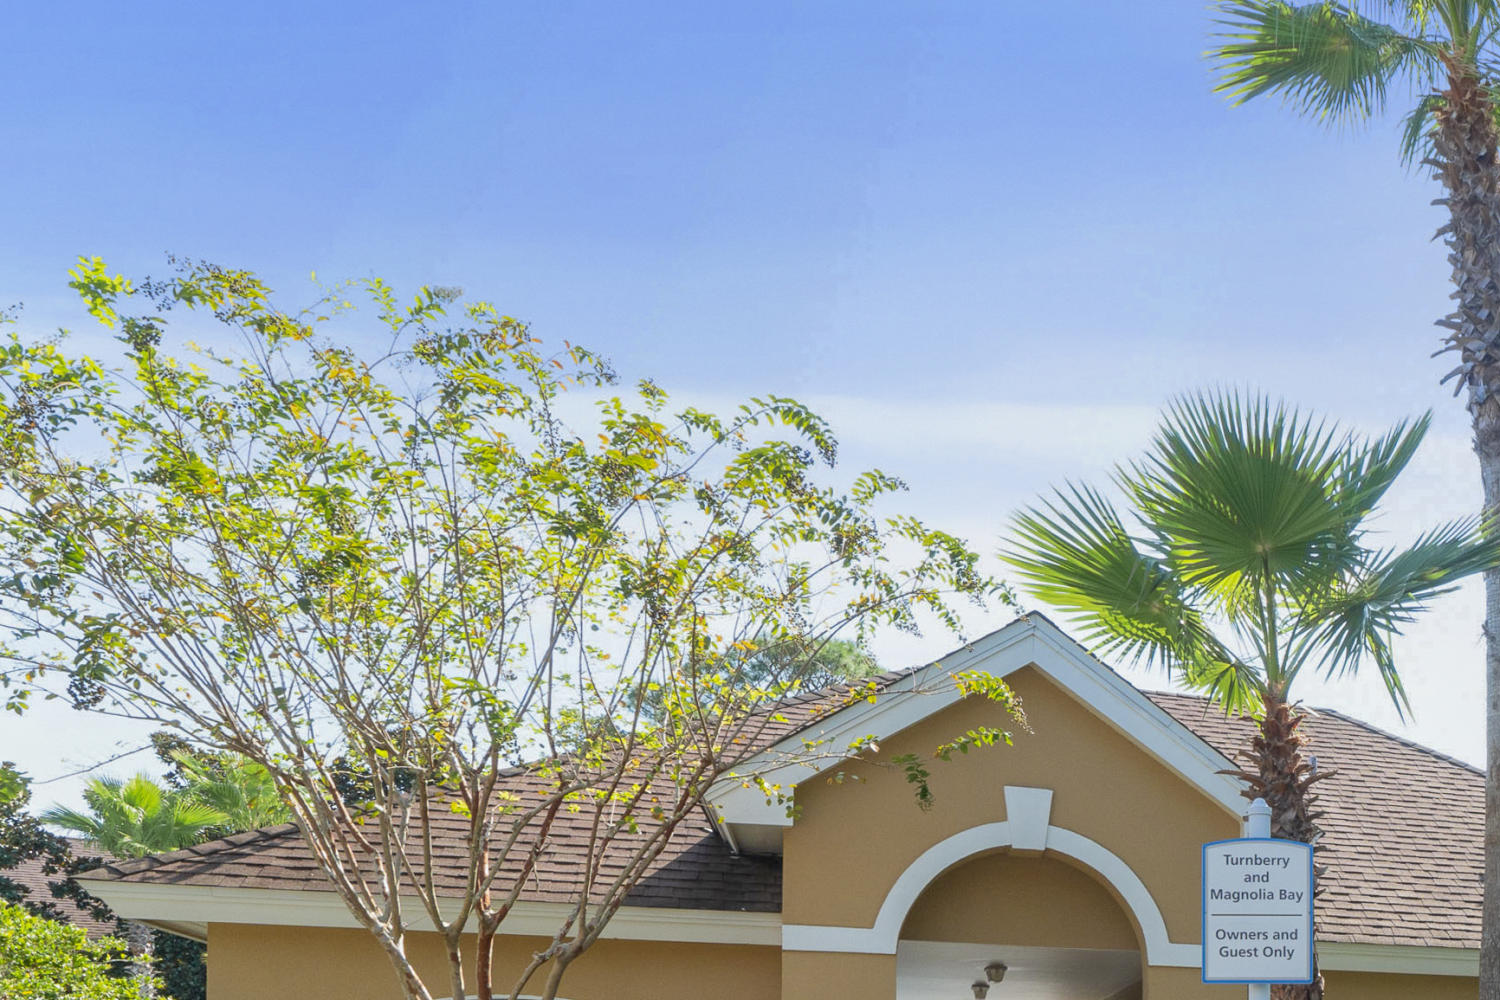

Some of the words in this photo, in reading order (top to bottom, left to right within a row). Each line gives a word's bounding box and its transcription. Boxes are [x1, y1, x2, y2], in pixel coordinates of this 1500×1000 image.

[1223, 854, 1290, 868] Turnberry
[1243, 872, 1270, 883] and
[1210, 889, 1274, 903] Magnolia
[1279, 889, 1304, 903] Bay
[1215, 929, 1269, 941] Owners
[1272, 929, 1298, 941] and
[1218, 946, 1259, 958] Guest
[1262, 946, 1295, 960] Only
